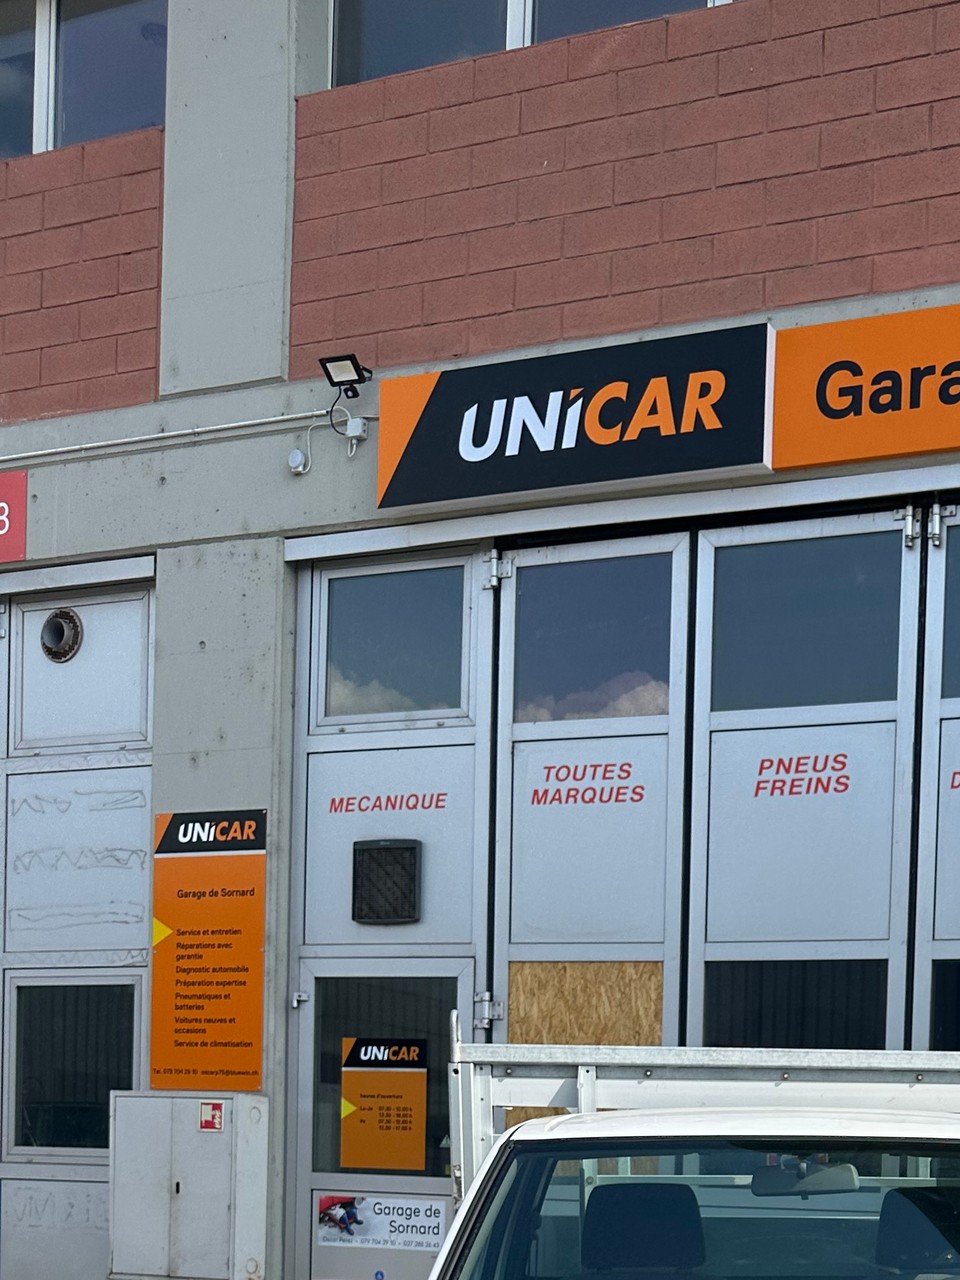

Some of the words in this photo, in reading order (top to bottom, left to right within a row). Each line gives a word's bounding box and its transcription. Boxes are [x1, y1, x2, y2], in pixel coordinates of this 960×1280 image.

[758, 753, 848, 776] PNEUS
[544, 762, 632, 783] TOUTES
[754, 776, 849, 797] FREINS
[530, 785, 645, 805] MARQUES
[329, 793, 448, 813] MECANIQUE
[177, 889, 207, 900] Garage
[208, 888, 219, 898] de
[220, 887, 255, 898] Sornard
[176, 928, 201, 937] Service
[211, 928, 242, 936] entretien
[176, 942, 216, 951] Réparations
[176, 953, 203, 962] garantie
[176, 965, 210, 975] Diagnostic
[212, 966, 249, 974] automobile
[176, 979, 214, 988] Préparation
[215, 979, 247, 988] expertise
[175, 992, 222, 1001] Pneumatiques
[223, 993, 231, 1001] et
[175, 1003, 204, 1011] batteries
[174, 1016, 202, 1024] Voitures
[174, 1039, 199, 1048] Service
[200, 1039, 208, 1048] de
[209, 1039, 253, 1048] climatisation
[372, 1201, 420, 1220] Garage
[425, 1204, 441, 1218] de
[389, 1220, 440, 1236] Sornard
